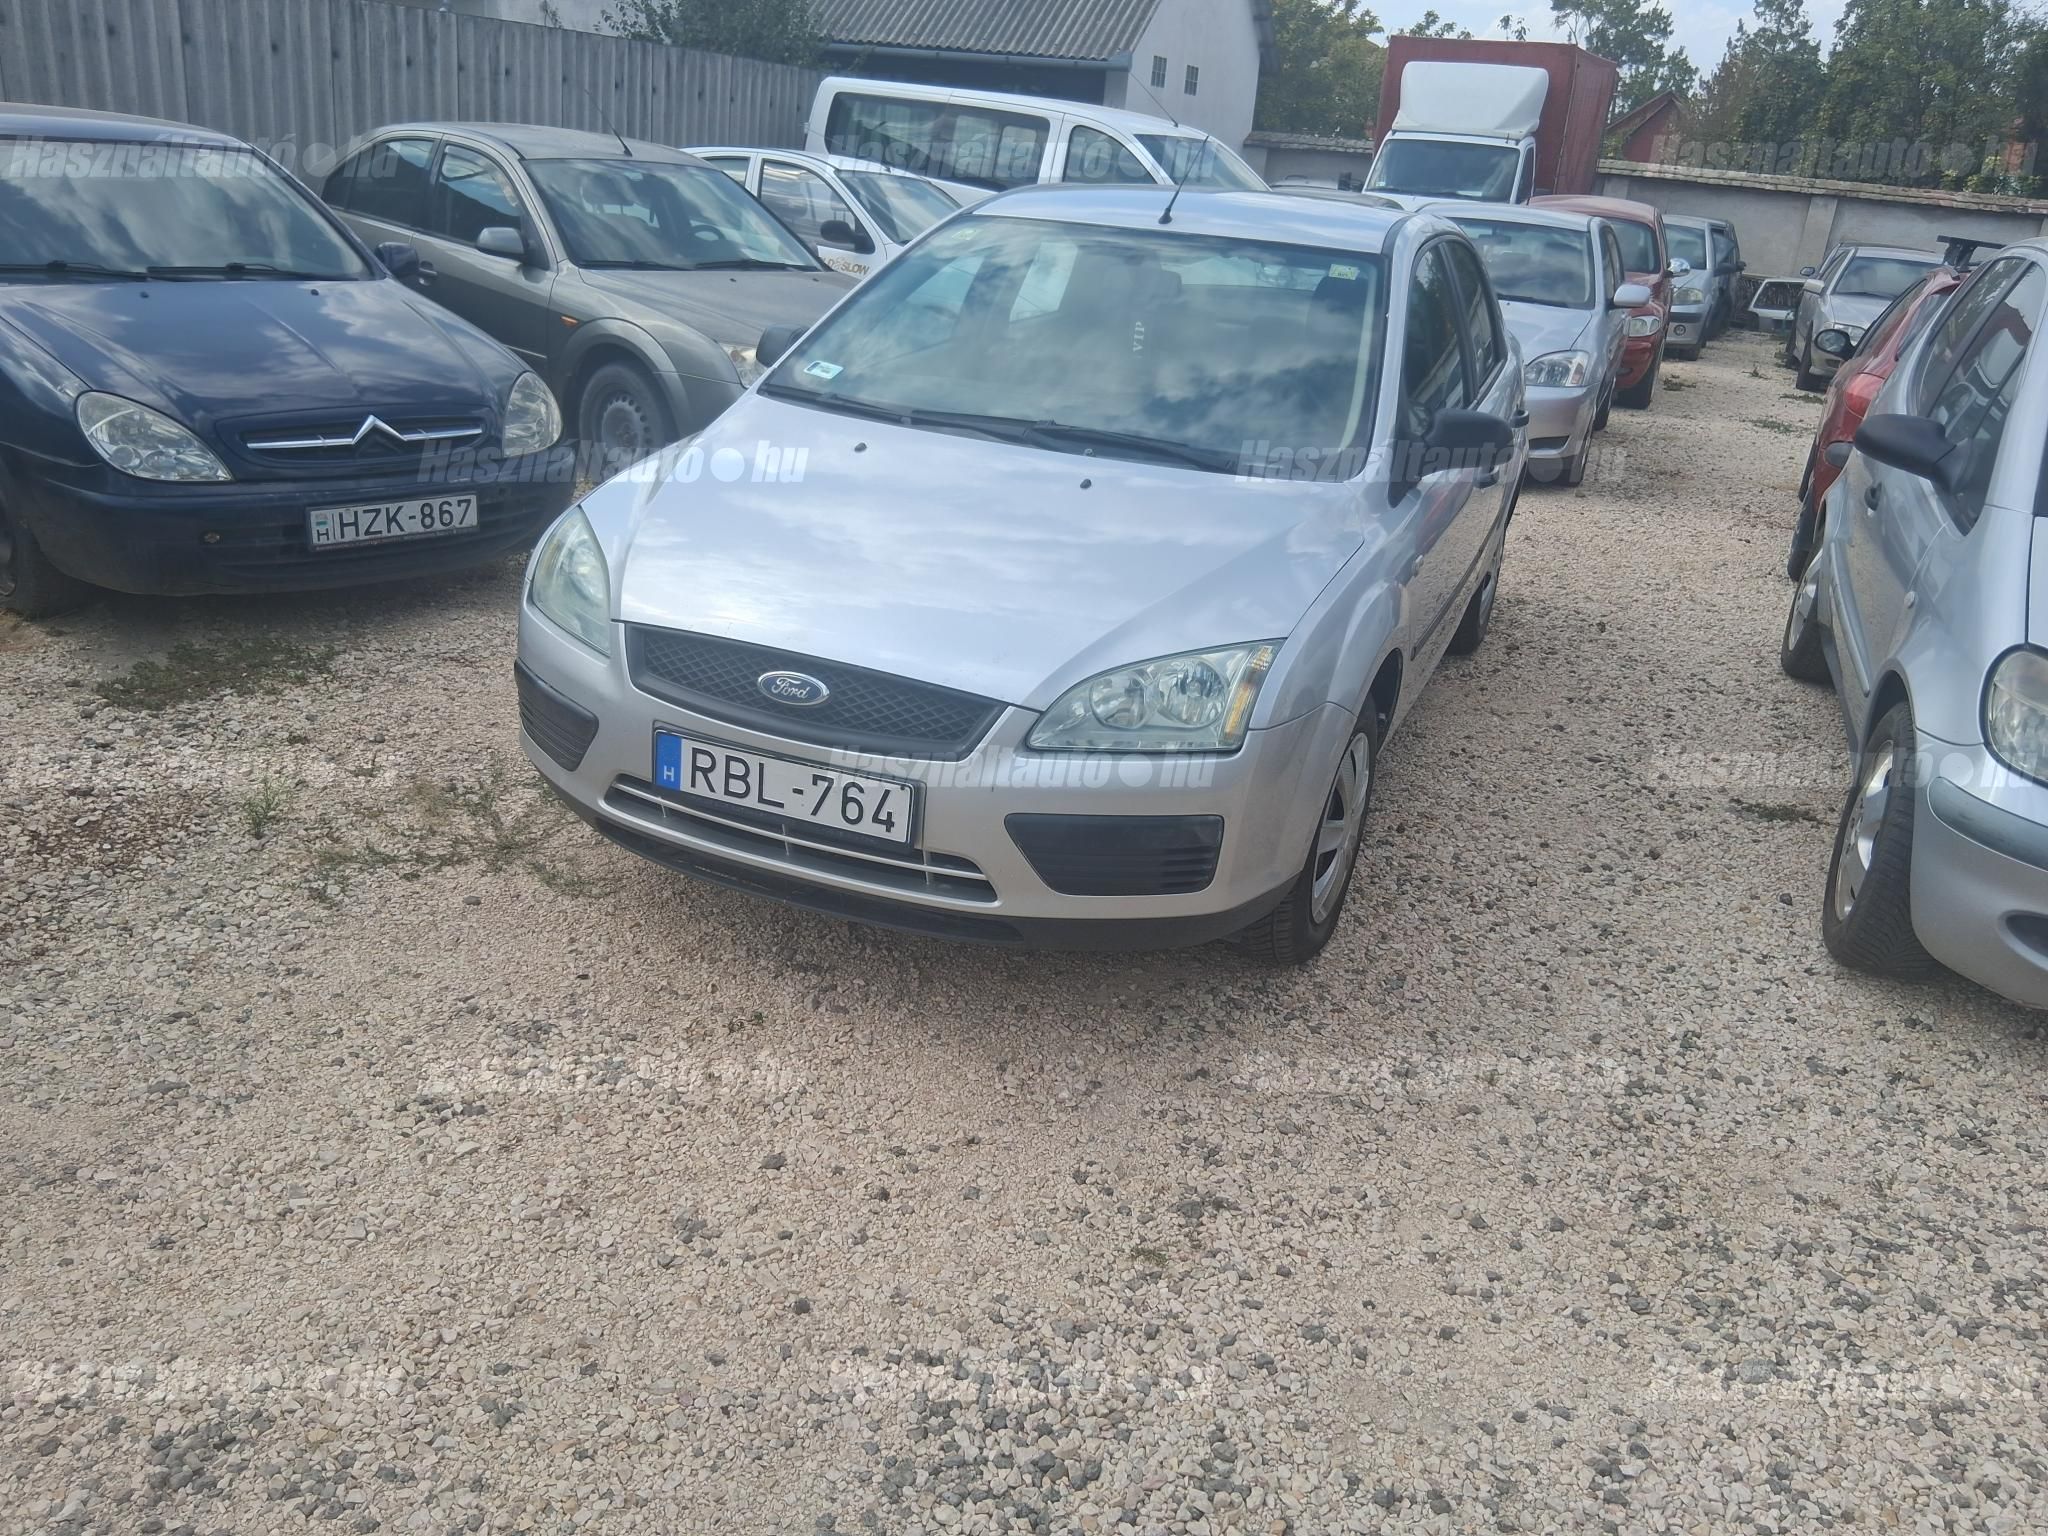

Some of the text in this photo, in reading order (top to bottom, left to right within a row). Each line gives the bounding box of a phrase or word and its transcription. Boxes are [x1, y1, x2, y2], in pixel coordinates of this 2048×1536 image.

[840, 261, 870, 275] SLOW
[1132, 321, 1144, 352] VIP
[316, 528, 330, 542] H
[338, 499, 472, 539] HZK-867
[771, 677, 811, 698] Ford
[663, 747, 895, 833] H RBL-764
